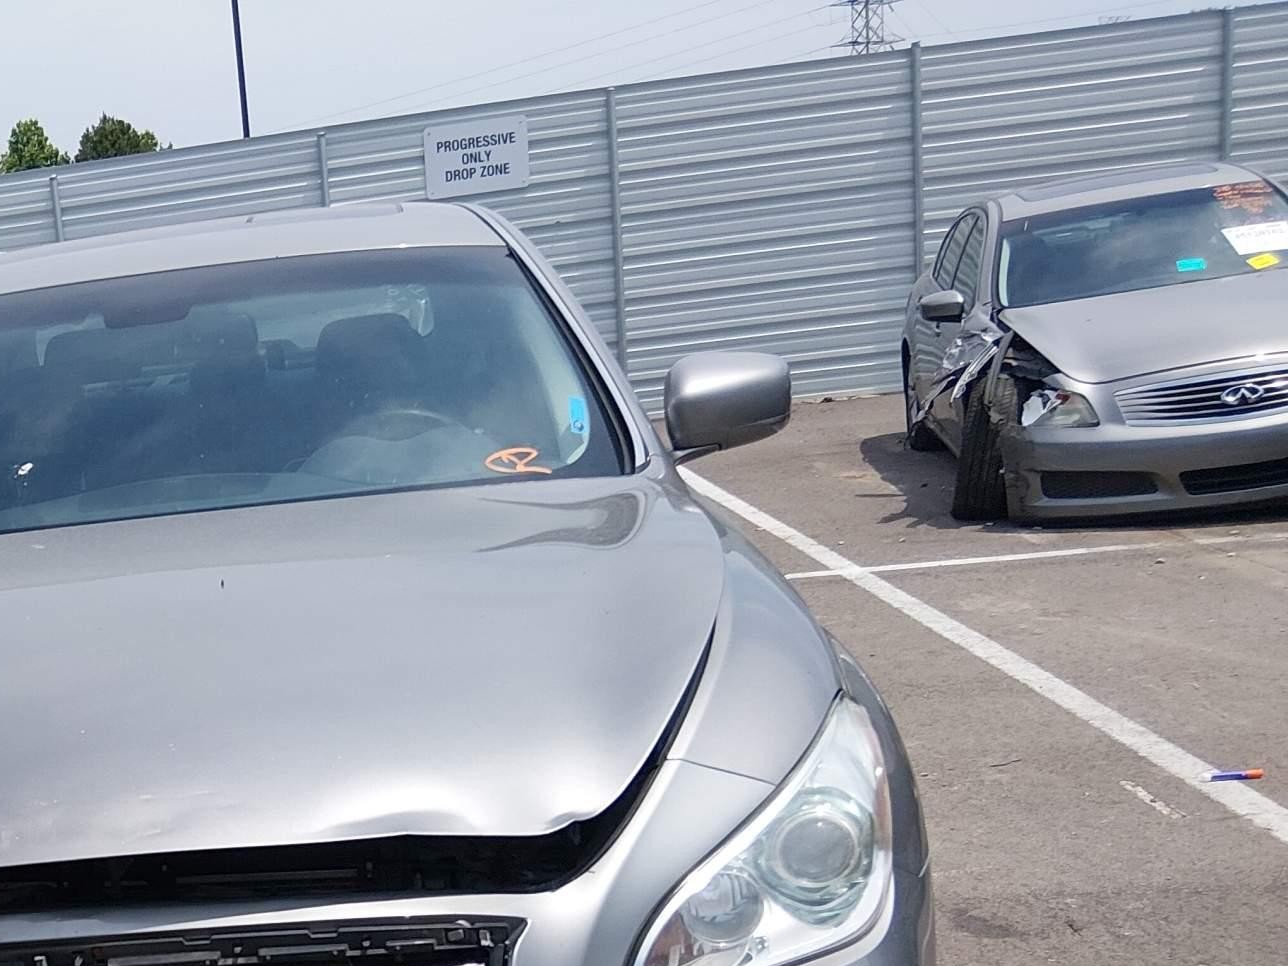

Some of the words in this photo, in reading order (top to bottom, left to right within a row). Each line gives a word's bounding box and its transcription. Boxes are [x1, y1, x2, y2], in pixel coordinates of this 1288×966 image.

[436, 132, 517, 153] PROGRESSIVE
[461, 150, 492, 165] ONLY
[445, 167, 477, 182] DROP
[480, 163, 511, 178] ZONE
